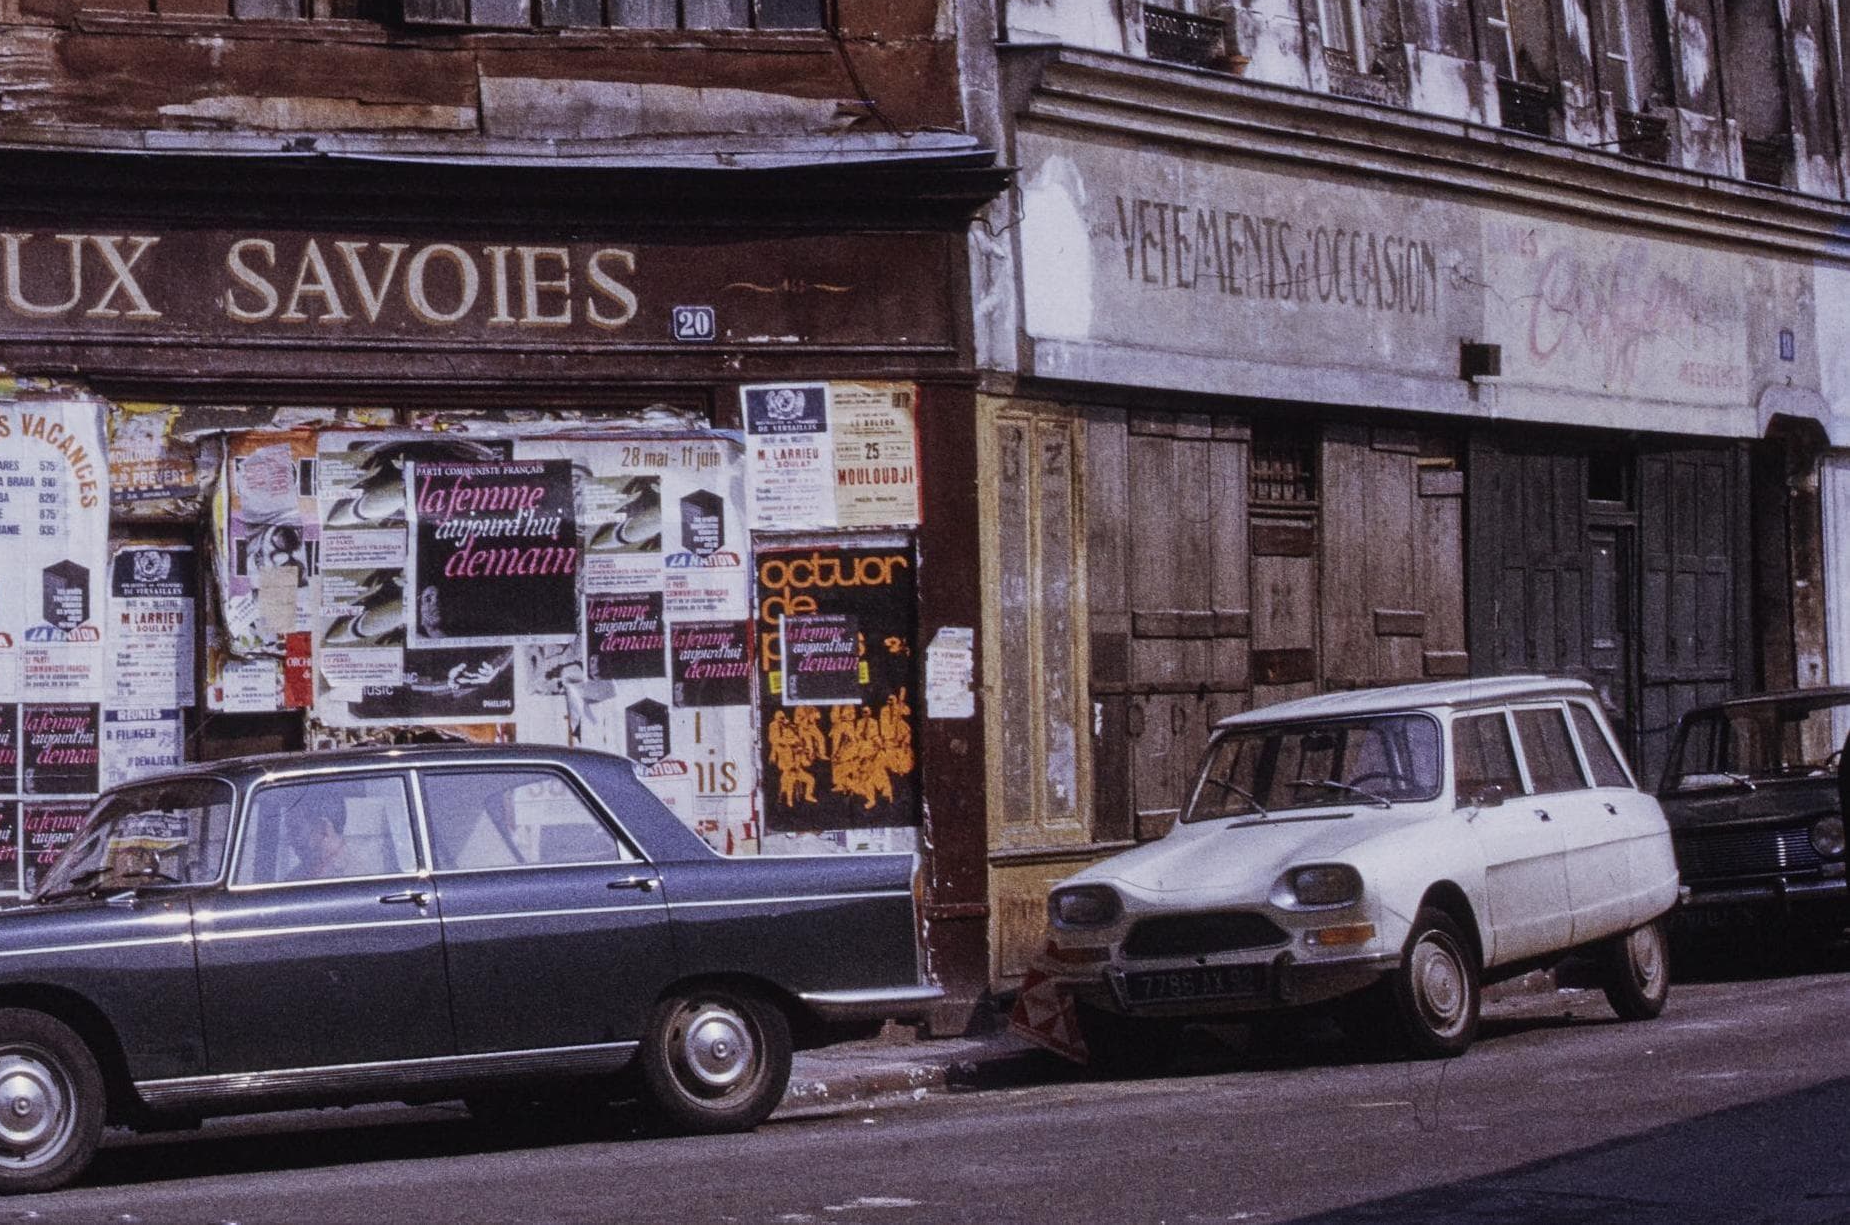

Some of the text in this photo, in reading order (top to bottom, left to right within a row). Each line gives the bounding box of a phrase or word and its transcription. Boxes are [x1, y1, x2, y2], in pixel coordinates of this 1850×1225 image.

[223, 238, 640, 331] SAVOIES
[679, 311, 710, 336] 20
[21, 413, 98, 509] VACANCES
[622, 447, 641, 467] 28
[645, 447, 668, 467] mai
[696, 447, 721, 471] juin
[774, 448, 819, 459] LARRIEU
[865, 443, 880, 459] 25
[837, 466, 914, 486] MOULOUDJI
[436, 474, 545, 525] femme
[435, 507, 563, 547] aujourd'hui
[444, 534, 577, 576] demain
[761, 552, 908, 589] octuor
[762, 585, 818, 624] de
